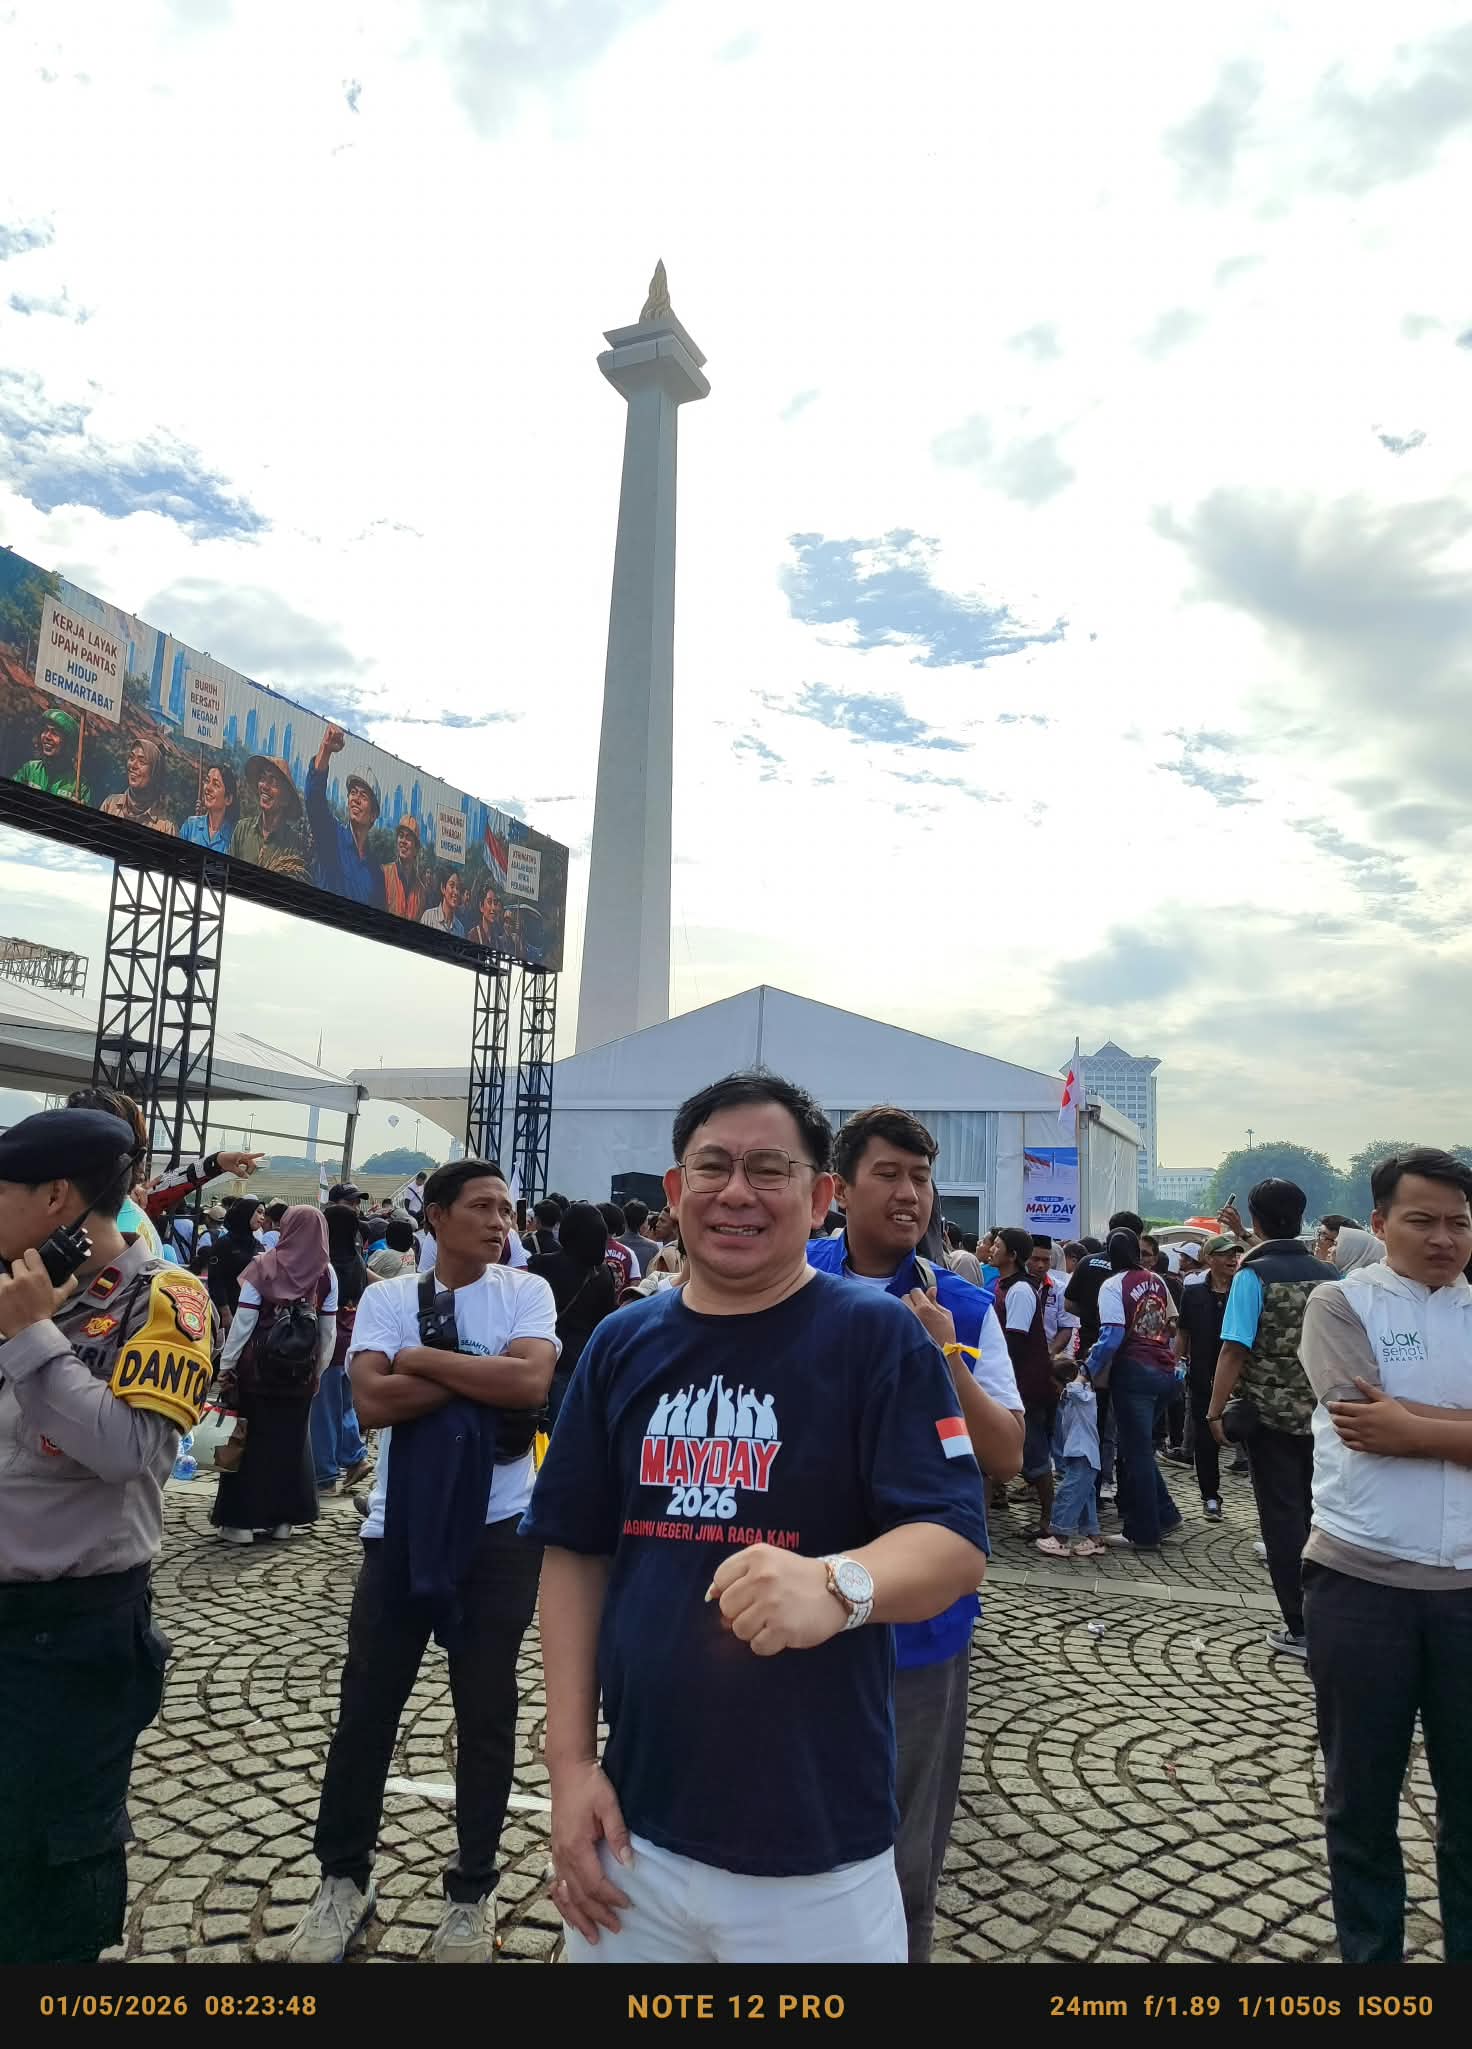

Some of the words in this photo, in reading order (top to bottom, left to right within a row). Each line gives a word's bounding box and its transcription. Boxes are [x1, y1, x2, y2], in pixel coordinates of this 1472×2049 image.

[52, 610, 85, 641] KERJA
[88, 631, 118, 659] LAYAK
[51, 631, 79, 656] UPAH
[80, 647, 117, 676] PANTAS
[67, 659, 98, 684] HIDUP
[44, 668, 115, 711] BERMARTABAT
[194, 679, 218, 697] BURUH
[190, 692, 220, 711] BERSATU
[191, 707, 218, 725] NEGARA
[197, 724, 213, 738] ADIL
[1026, 1203, 1051, 1213] MAY
[1052, 1204, 1077, 1215] DAY
[1382, 1345, 1424, 1357] sehat
[640, 1436, 782, 1492] MAYDAY
[666, 1486, 738, 1520] 2026
[655, 1521, 694, 1542] NEGERI
[695, 1524, 725, 1543] JIWA
[727, 1526, 763, 1545] RAGA
[766, 1529, 801, 1549] KAMI
